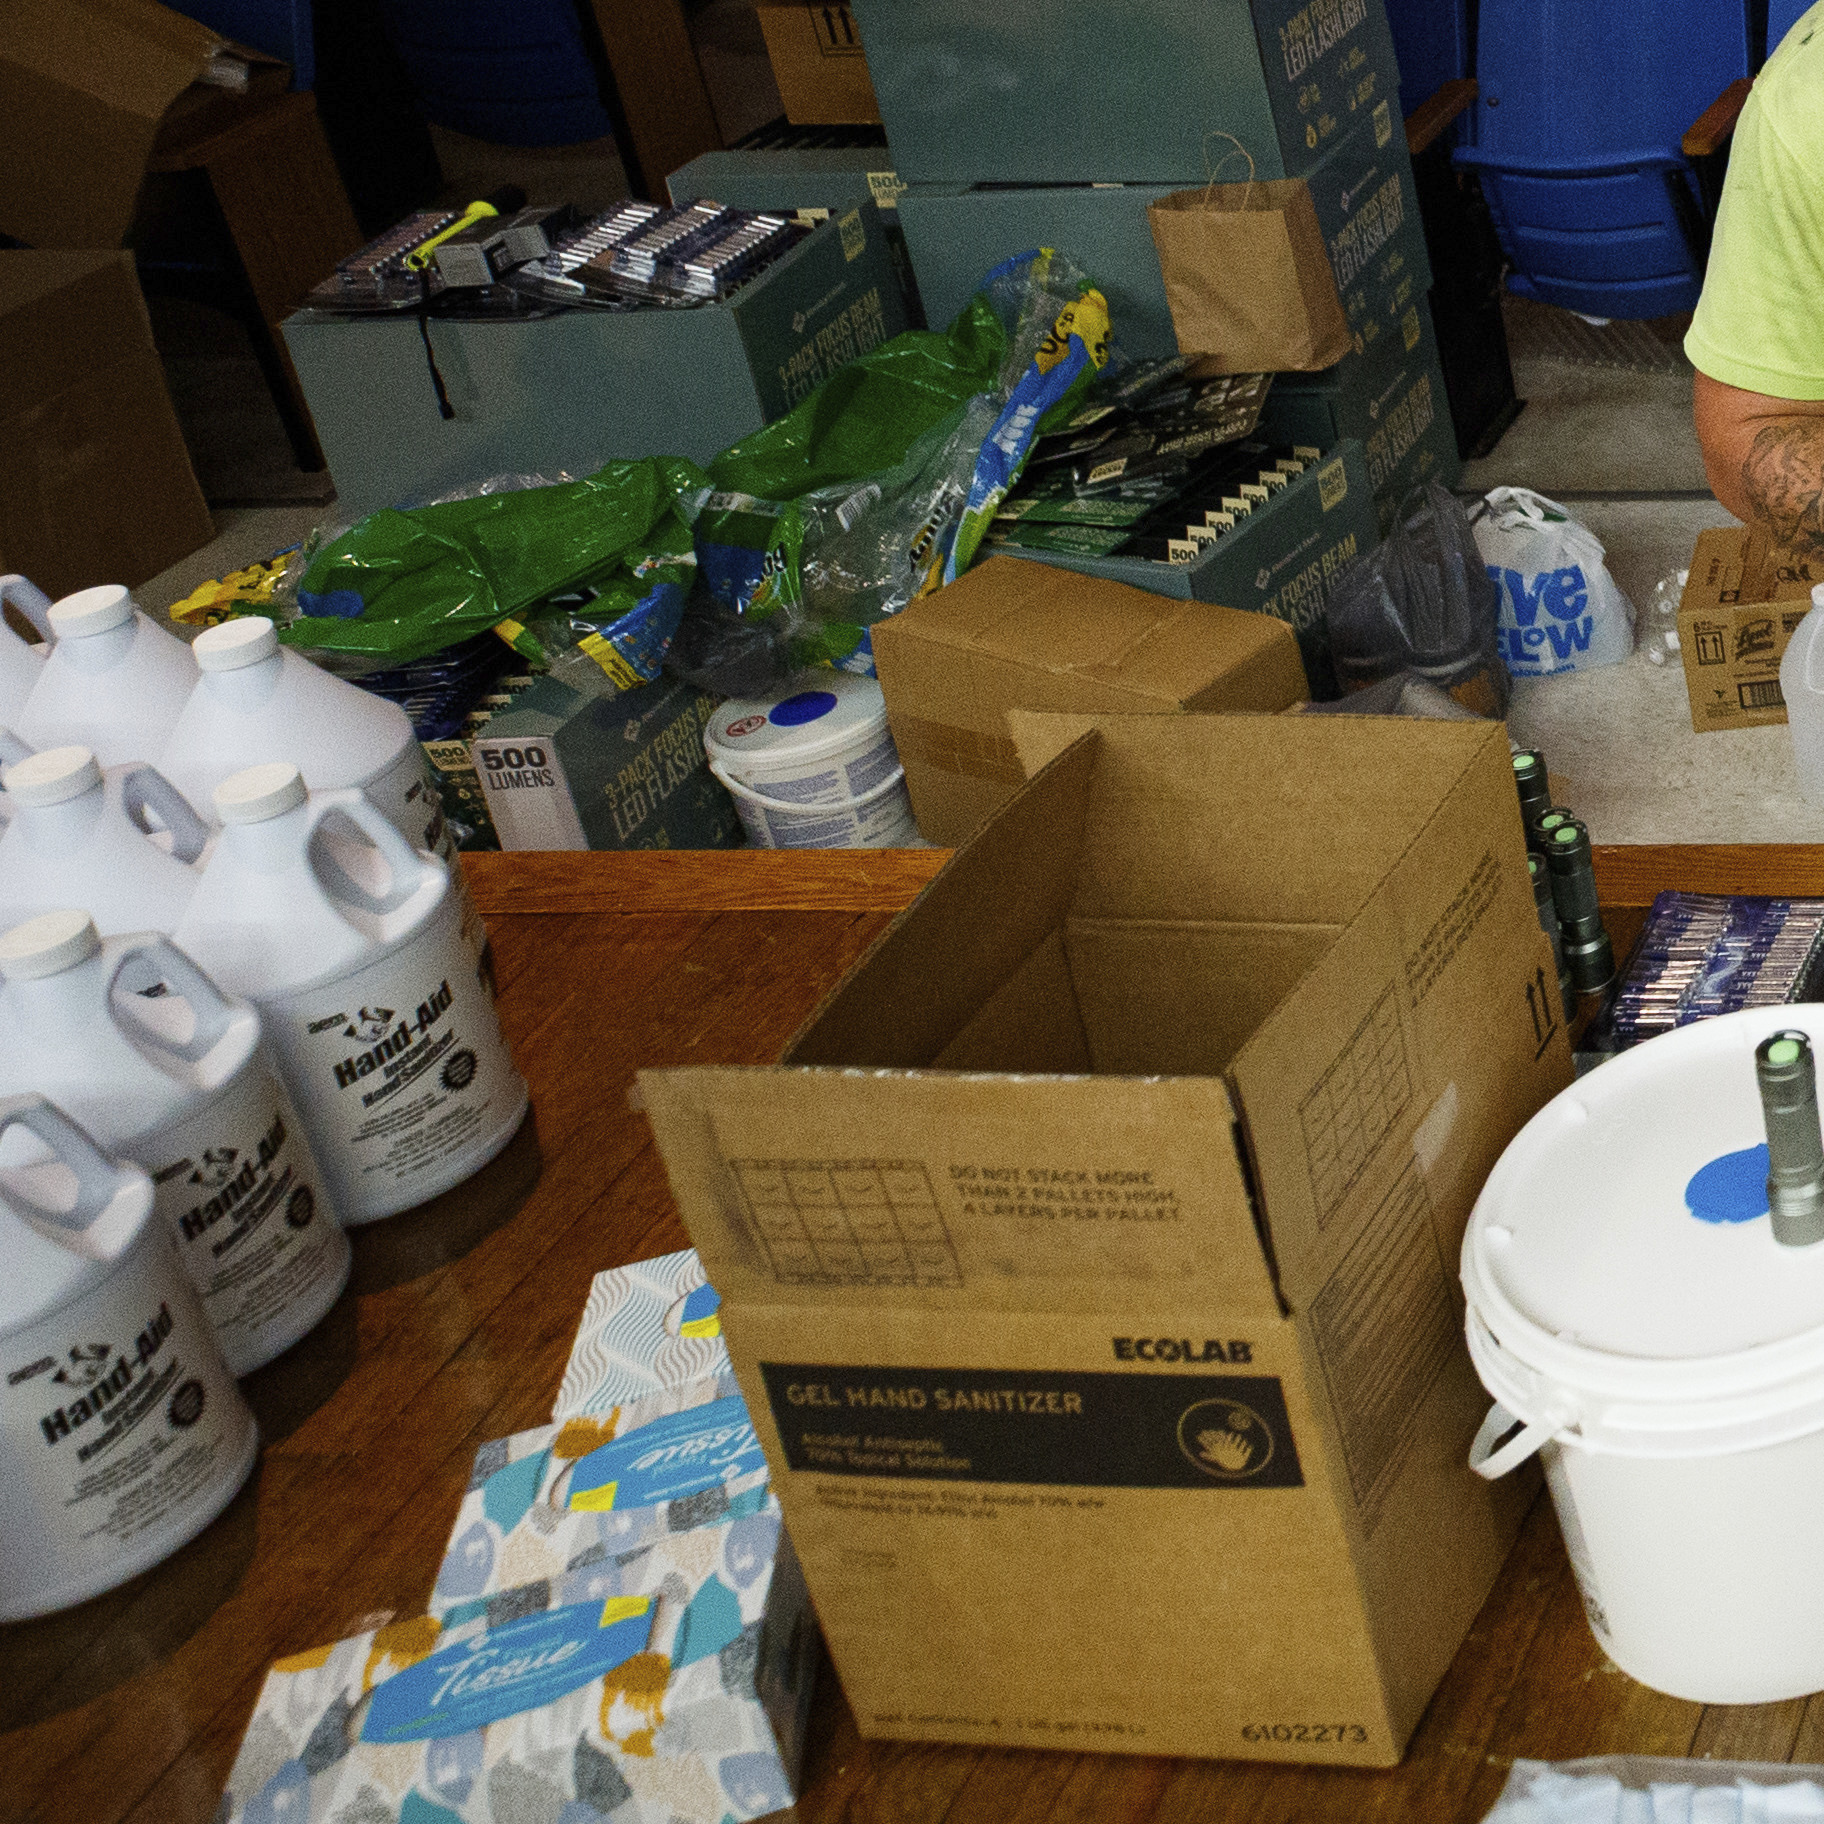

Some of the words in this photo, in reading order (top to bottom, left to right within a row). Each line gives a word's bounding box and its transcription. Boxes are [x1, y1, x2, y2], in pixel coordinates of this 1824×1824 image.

[1280, 564, 1324, 613] FOCUS
[1319, 531, 1357, 576] BEAM
[481, 746, 547, 771] 500
[487, 769, 555, 791] LUMENS
[603, 746, 655, 811] 3-PACK
[652, 706, 698, 757] FOCUS
[609, 792, 651, 843] LED
[333, 979, 454, 1090] Hand-Aid
[180, 1114, 288, 1243] Hand-Aid
[40, 1301, 174, 1446] Hand-Aid
[1112, 1337, 1254, 1364] ECOLAB
[786, 1382, 842, 1409] GEL
[846, 1386, 928, 1412] HAND
[933, 1387, 1085, 1416] SANITIZER
[431, 1639, 590, 1707] Tissue
[1242, 1723, 1370, 1744] 6102273
